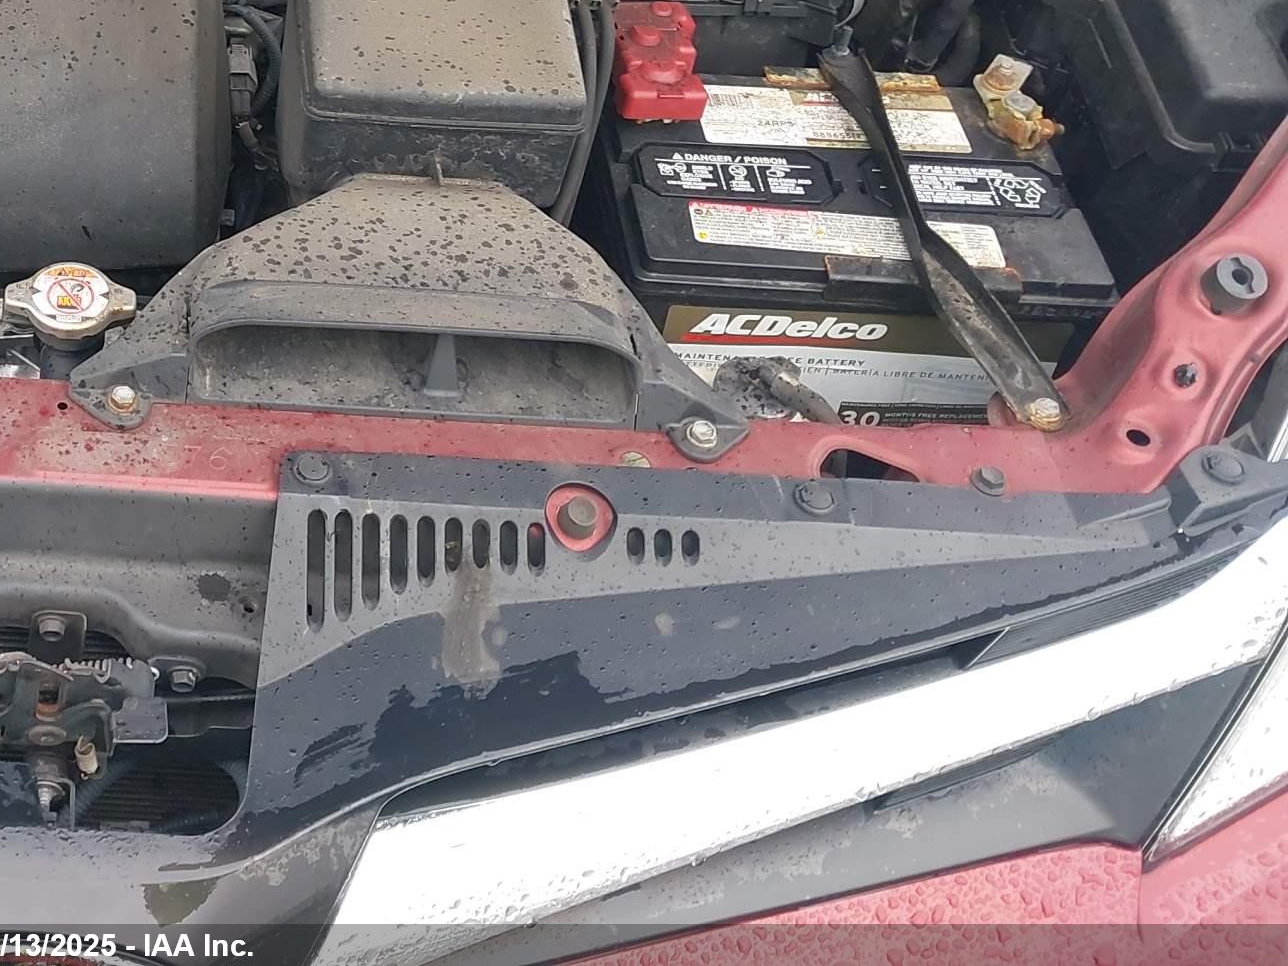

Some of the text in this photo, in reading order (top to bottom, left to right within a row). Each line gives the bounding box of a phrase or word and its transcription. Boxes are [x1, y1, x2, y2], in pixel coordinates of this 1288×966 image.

[684, 153, 732, 163] DANGER
[744, 155, 788, 165] POISON
[689, 313, 888, 341] ACDelco
[807, 358, 866, 367] BATTERY
[883, 370, 914, 379] LIBRE
[840, 410, 881, 426] 30
